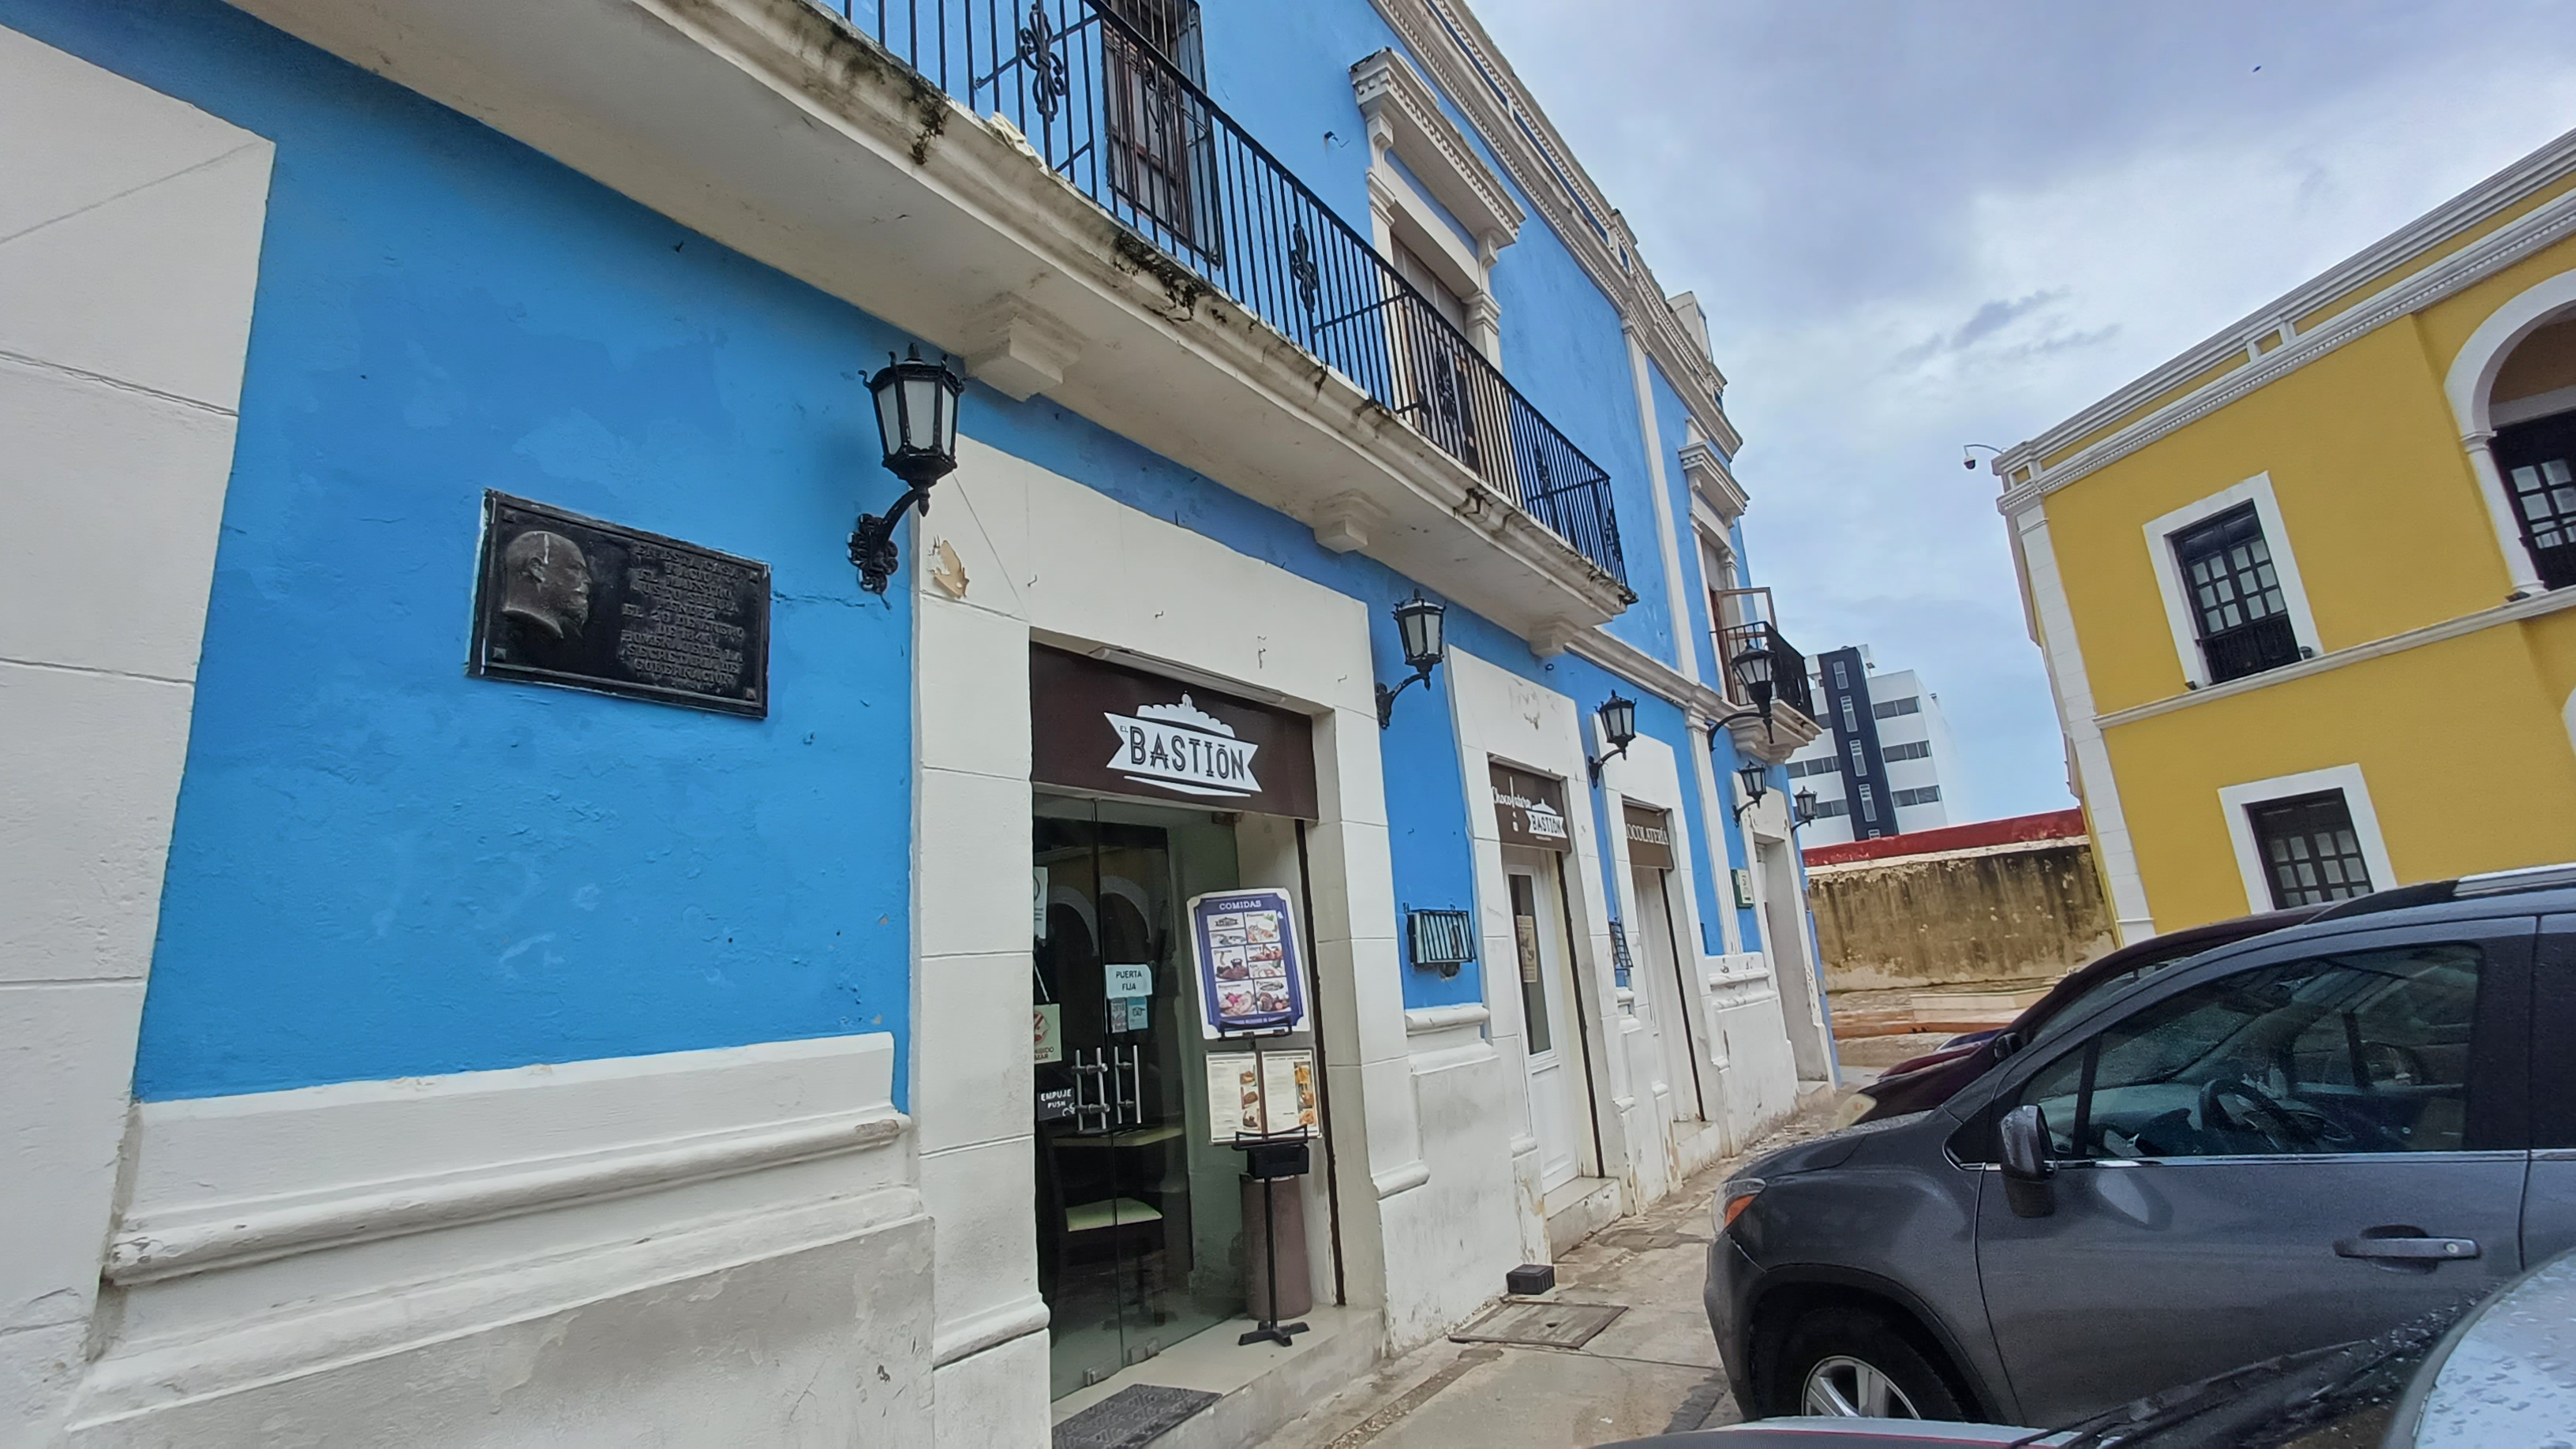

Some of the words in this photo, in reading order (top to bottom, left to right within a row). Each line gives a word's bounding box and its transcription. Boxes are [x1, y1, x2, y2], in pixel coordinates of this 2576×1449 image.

[622, 602, 643, 619] EL
[1219, 900, 1262, 911] COMIDAS
[1116, 970, 1142, 979] PUERTA
[1121, 983, 1136, 991] FIJA
[1040, 1088, 1072, 1102] EMPUJE
[1047, 1100, 1066, 1109] PUSH
